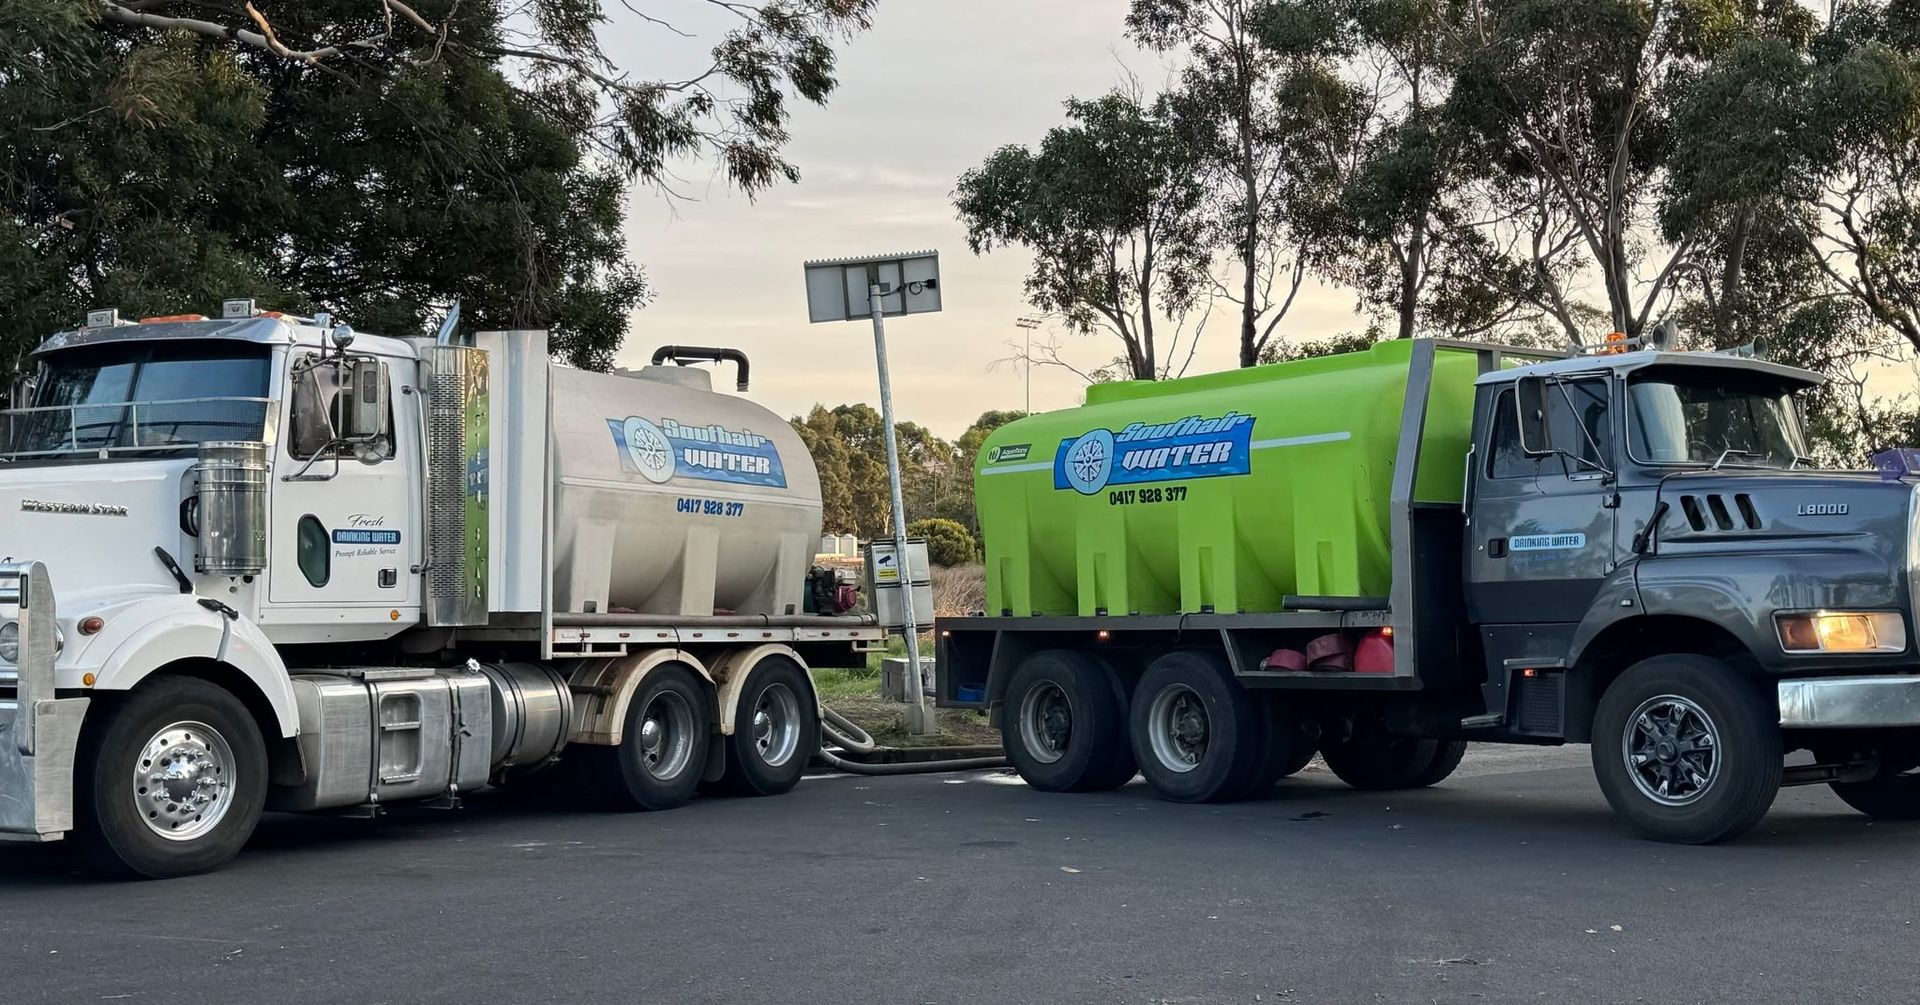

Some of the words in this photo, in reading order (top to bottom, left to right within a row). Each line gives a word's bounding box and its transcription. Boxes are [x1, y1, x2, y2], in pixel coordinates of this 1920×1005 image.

[661, 418, 767, 449] Southair
[1116, 411, 1251, 442] Southair
[683, 447, 771, 475] WATER
[1121, 441, 1233, 471] WATER
[1109, 490, 1136, 506] 0417
[1139, 488, 1162, 504] 928
[1165, 486, 1188, 501] 377
[20, 499, 90, 515] WESTERN
[91, 503, 129, 517] STAR
[677, 498, 701, 513] 0417
[703, 500, 723, 515] 928
[725, 502, 744, 517] 377
[1797, 503, 1849, 516] L8000
[347, 513, 384, 528] Fresh
[336, 531, 371, 542] DRINKING
[371, 532, 397, 543] WATER
[1514, 536, 1550, 548] DRINKING
[1551, 535, 1580, 547] WATER
